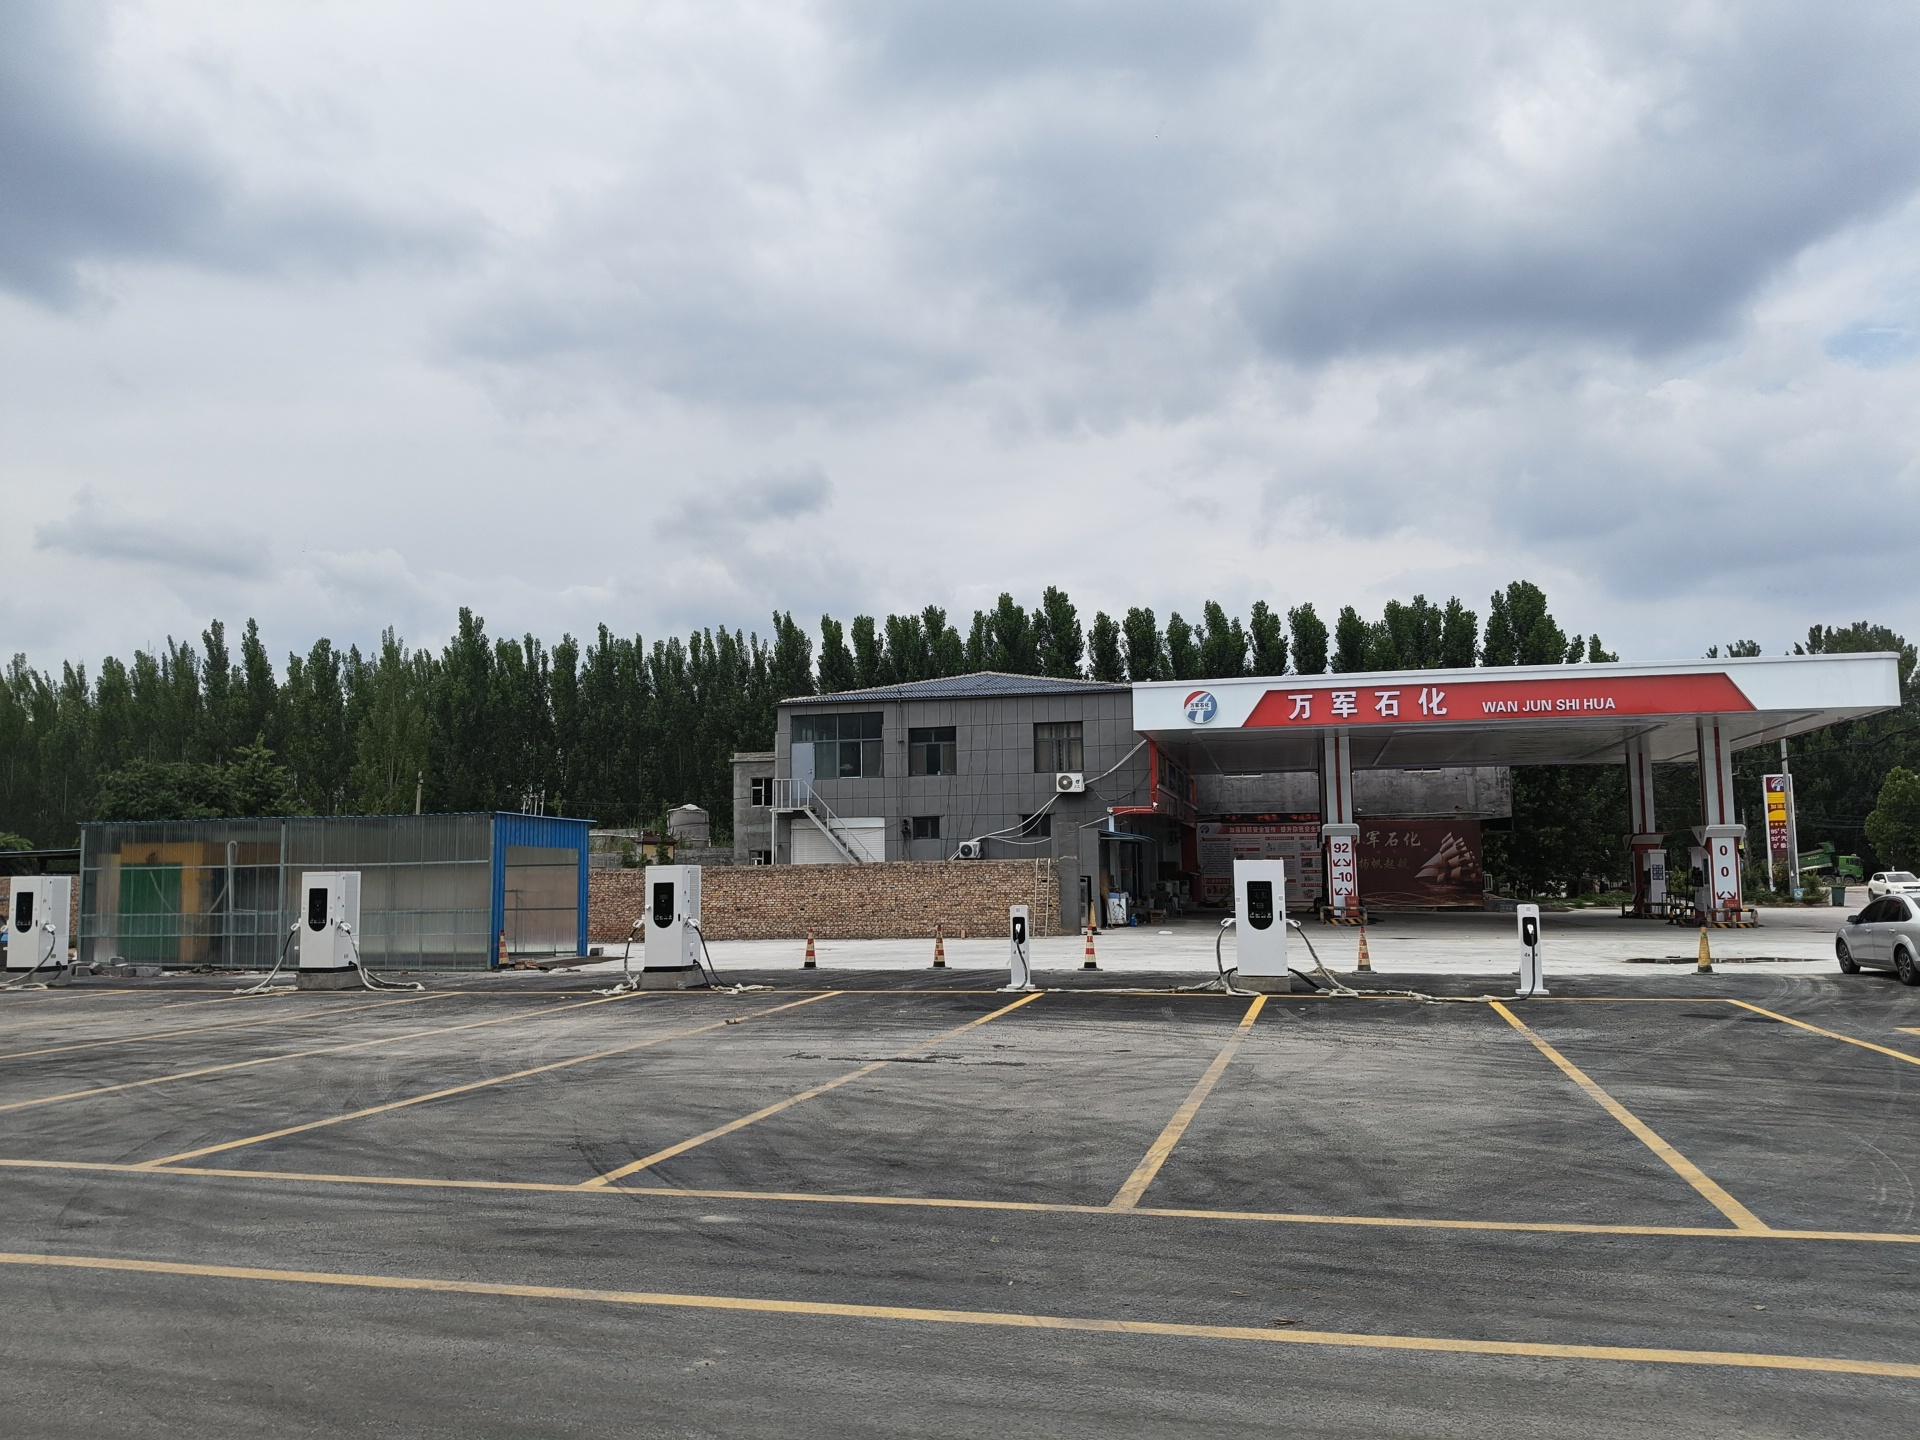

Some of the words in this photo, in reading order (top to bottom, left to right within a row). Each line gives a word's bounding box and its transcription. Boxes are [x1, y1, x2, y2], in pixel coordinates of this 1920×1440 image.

[1288, 688, 1448, 719] 万军石化
[1482, 701, 1518, 713] WAN
[1522, 700, 1552, 712] JUN
[1556, 699, 1580, 711] SHI
[1584, 697, 1616, 710] HUA
[1361, 831, 1421, 848] 军石化
[1333, 843, 1349, 853] 92
[1720, 845, 1728, 856] 0
[1721, 866, 1729, 877] 0
